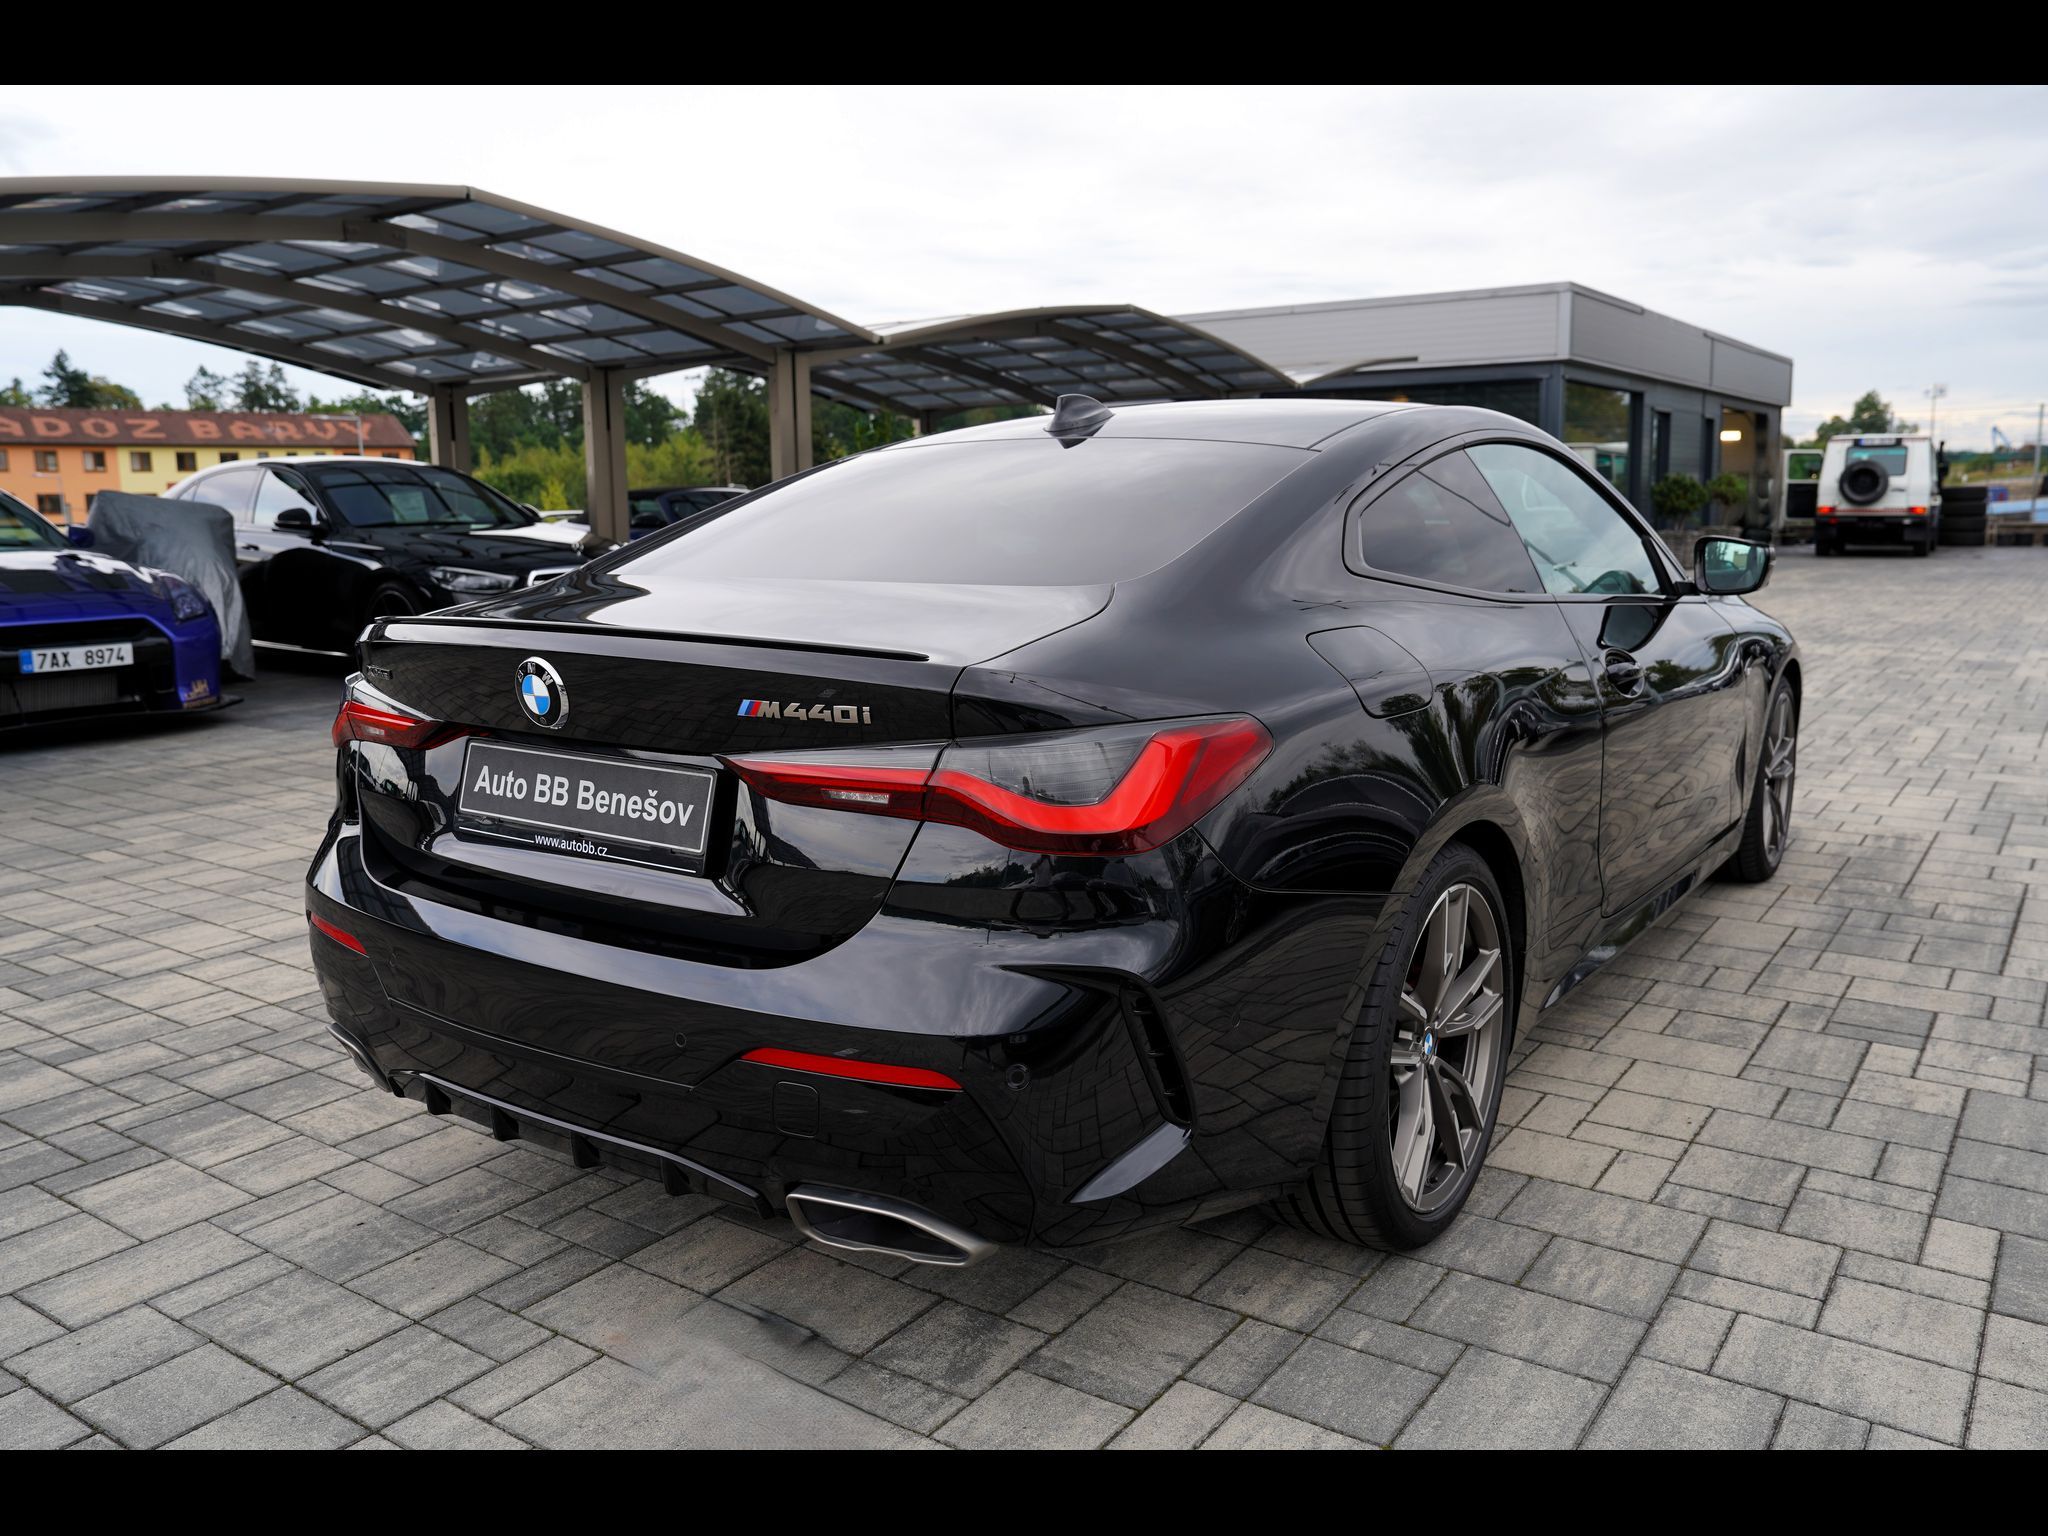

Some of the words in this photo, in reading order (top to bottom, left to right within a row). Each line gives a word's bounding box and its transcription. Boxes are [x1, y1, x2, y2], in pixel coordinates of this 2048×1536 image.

[37, 652, 72, 670] 7AX
[85, 647, 124, 665] 8974
[517, 662, 554, 686] BMW
[756, 700, 871, 724] M440i
[473, 765, 528, 800] Auto
[533, 773, 570, 807] BB
[576, 779, 694, 827] Benešov
[534, 833, 608, 857] www.autobb.cz
